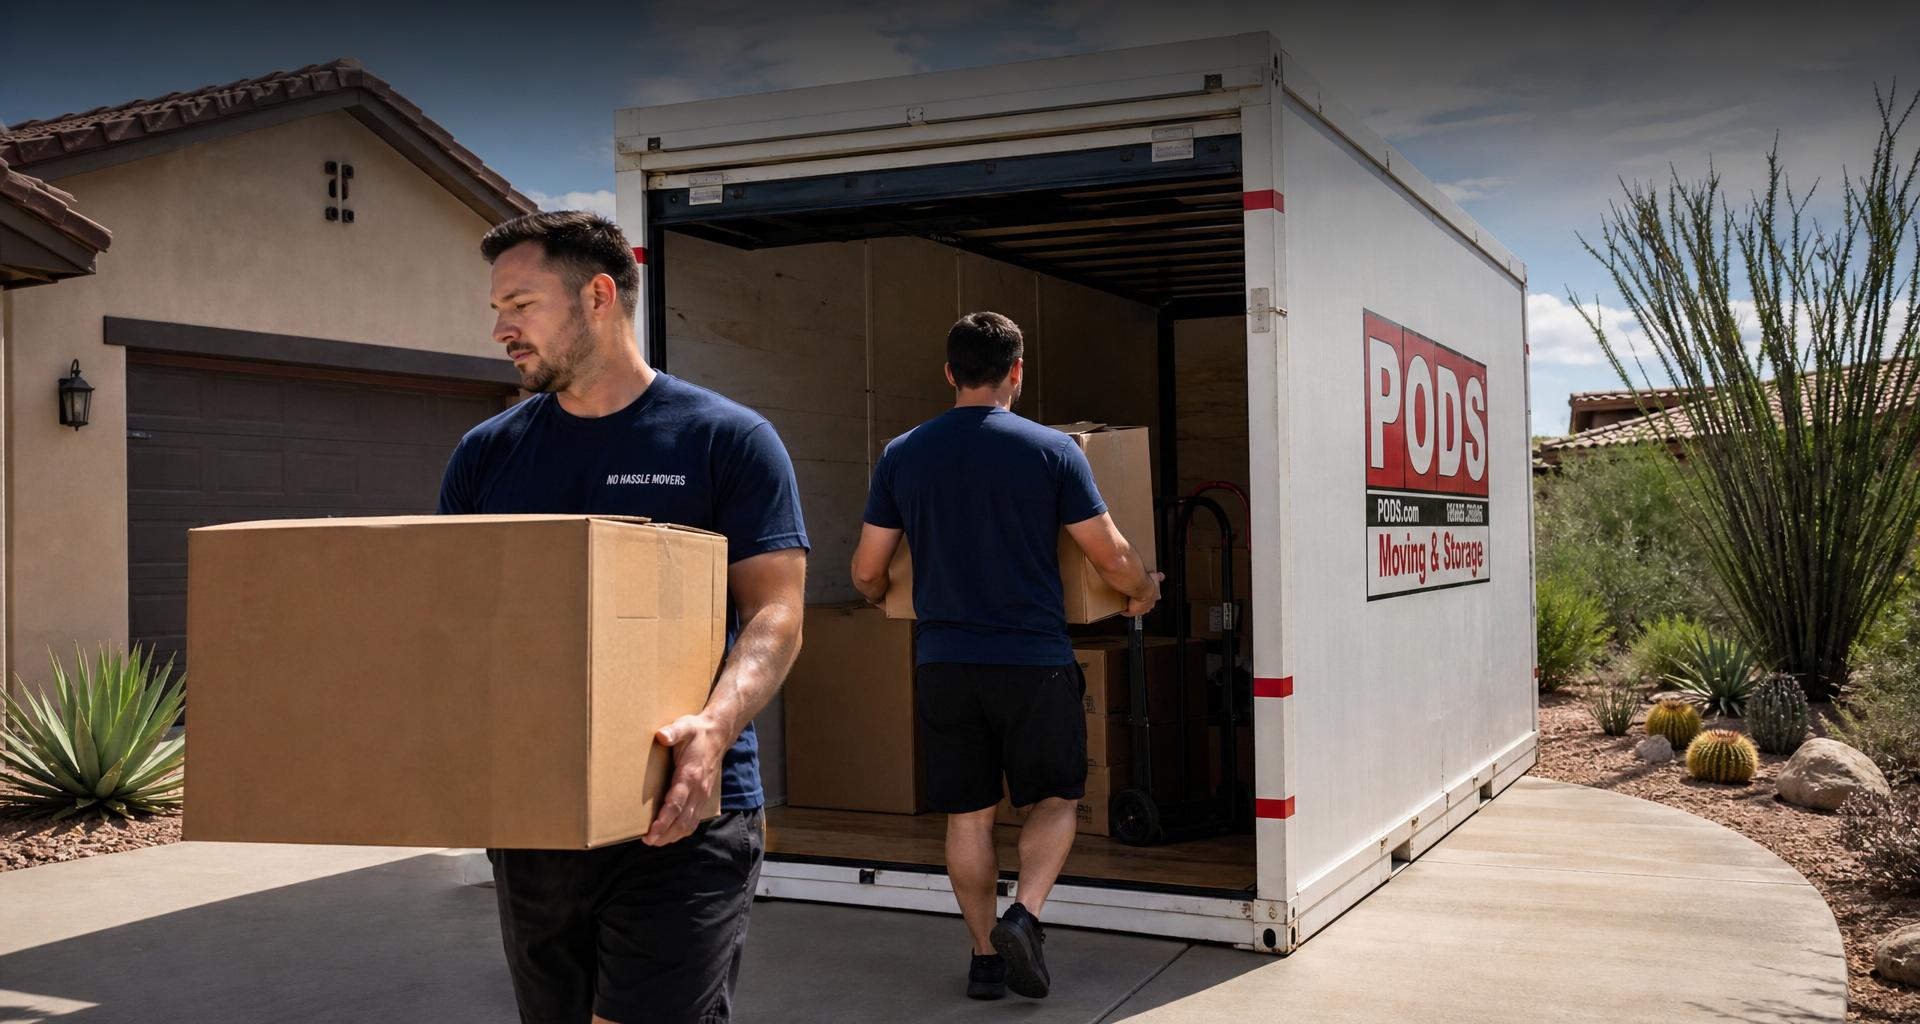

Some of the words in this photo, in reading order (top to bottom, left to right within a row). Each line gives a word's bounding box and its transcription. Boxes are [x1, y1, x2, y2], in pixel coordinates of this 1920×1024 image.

[1369, 336, 1486, 482] PODS
[606, 474, 619, 485] NO
[620, 474, 651, 485] HASSLE
[651, 474, 686, 486] MOVERS
[1377, 498, 1420, 523] PODS.com
[1379, 532, 1426, 585] Moving
[1430, 531, 1440, 572] &
[1443, 531, 1483, 578] Storage
